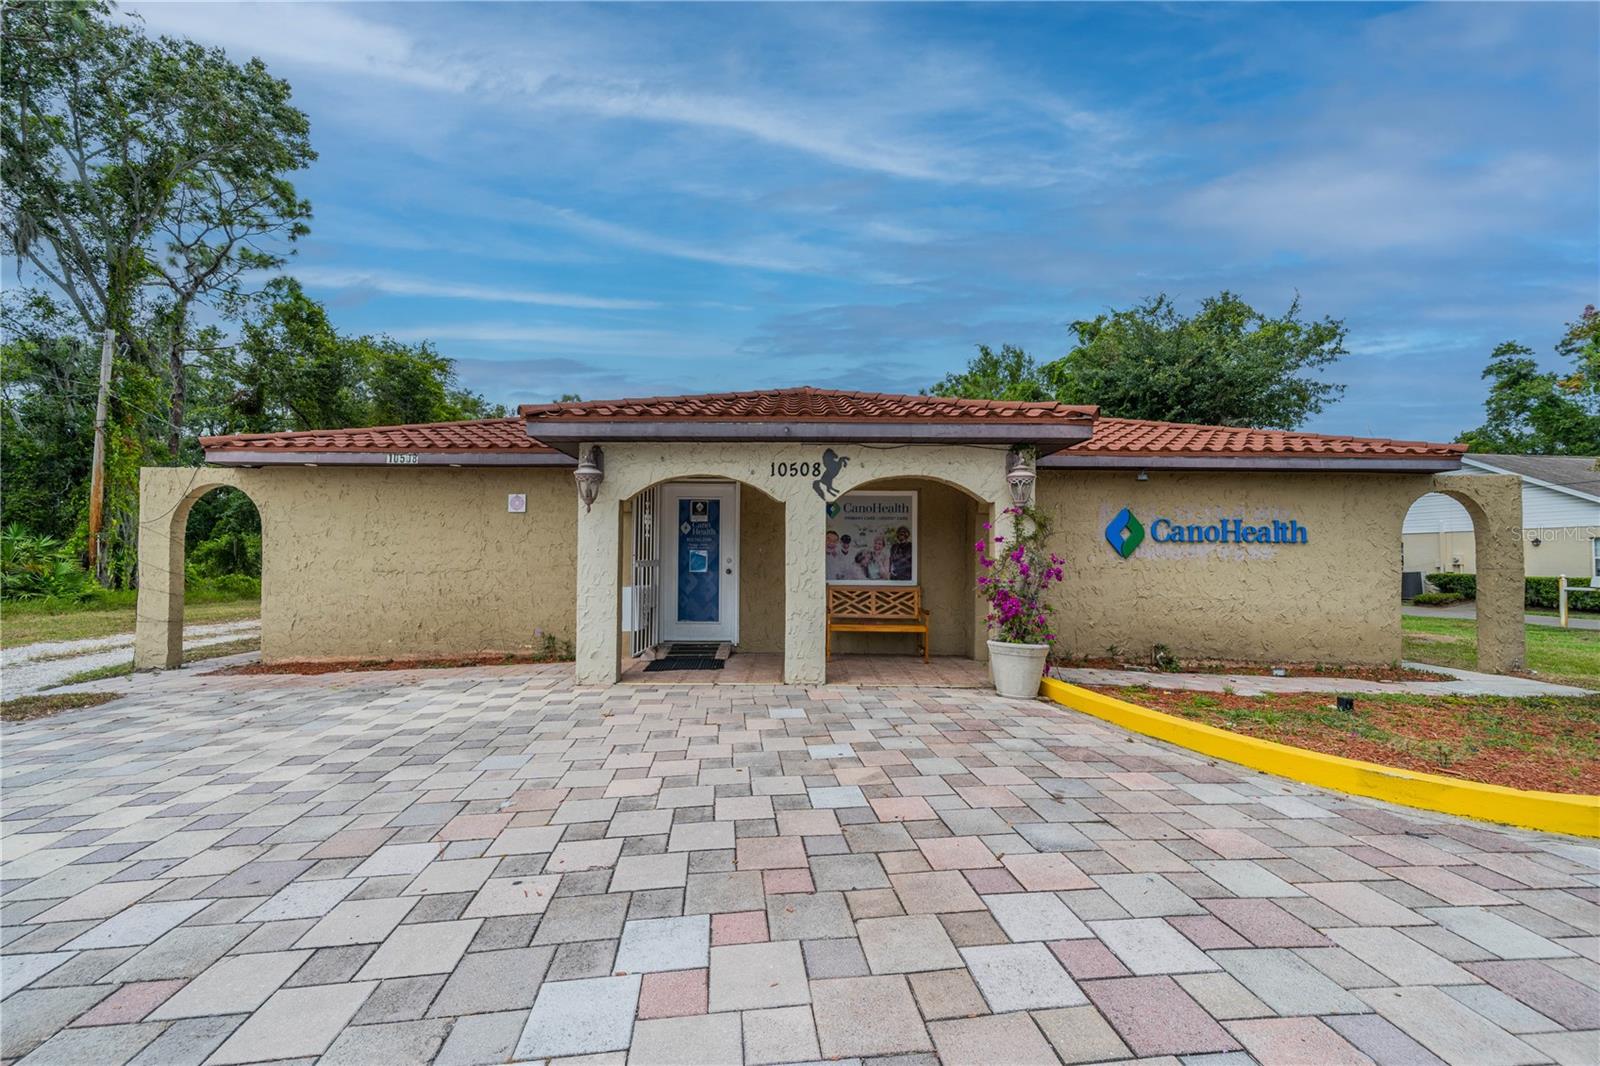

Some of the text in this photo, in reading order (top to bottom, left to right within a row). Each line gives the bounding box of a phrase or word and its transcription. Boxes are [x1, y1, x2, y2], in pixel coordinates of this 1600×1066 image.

[770, 462, 821, 477] 10508
[843, 502, 909, 513] CanoHealth
[1150, 518, 1308, 544] CanoHealth
